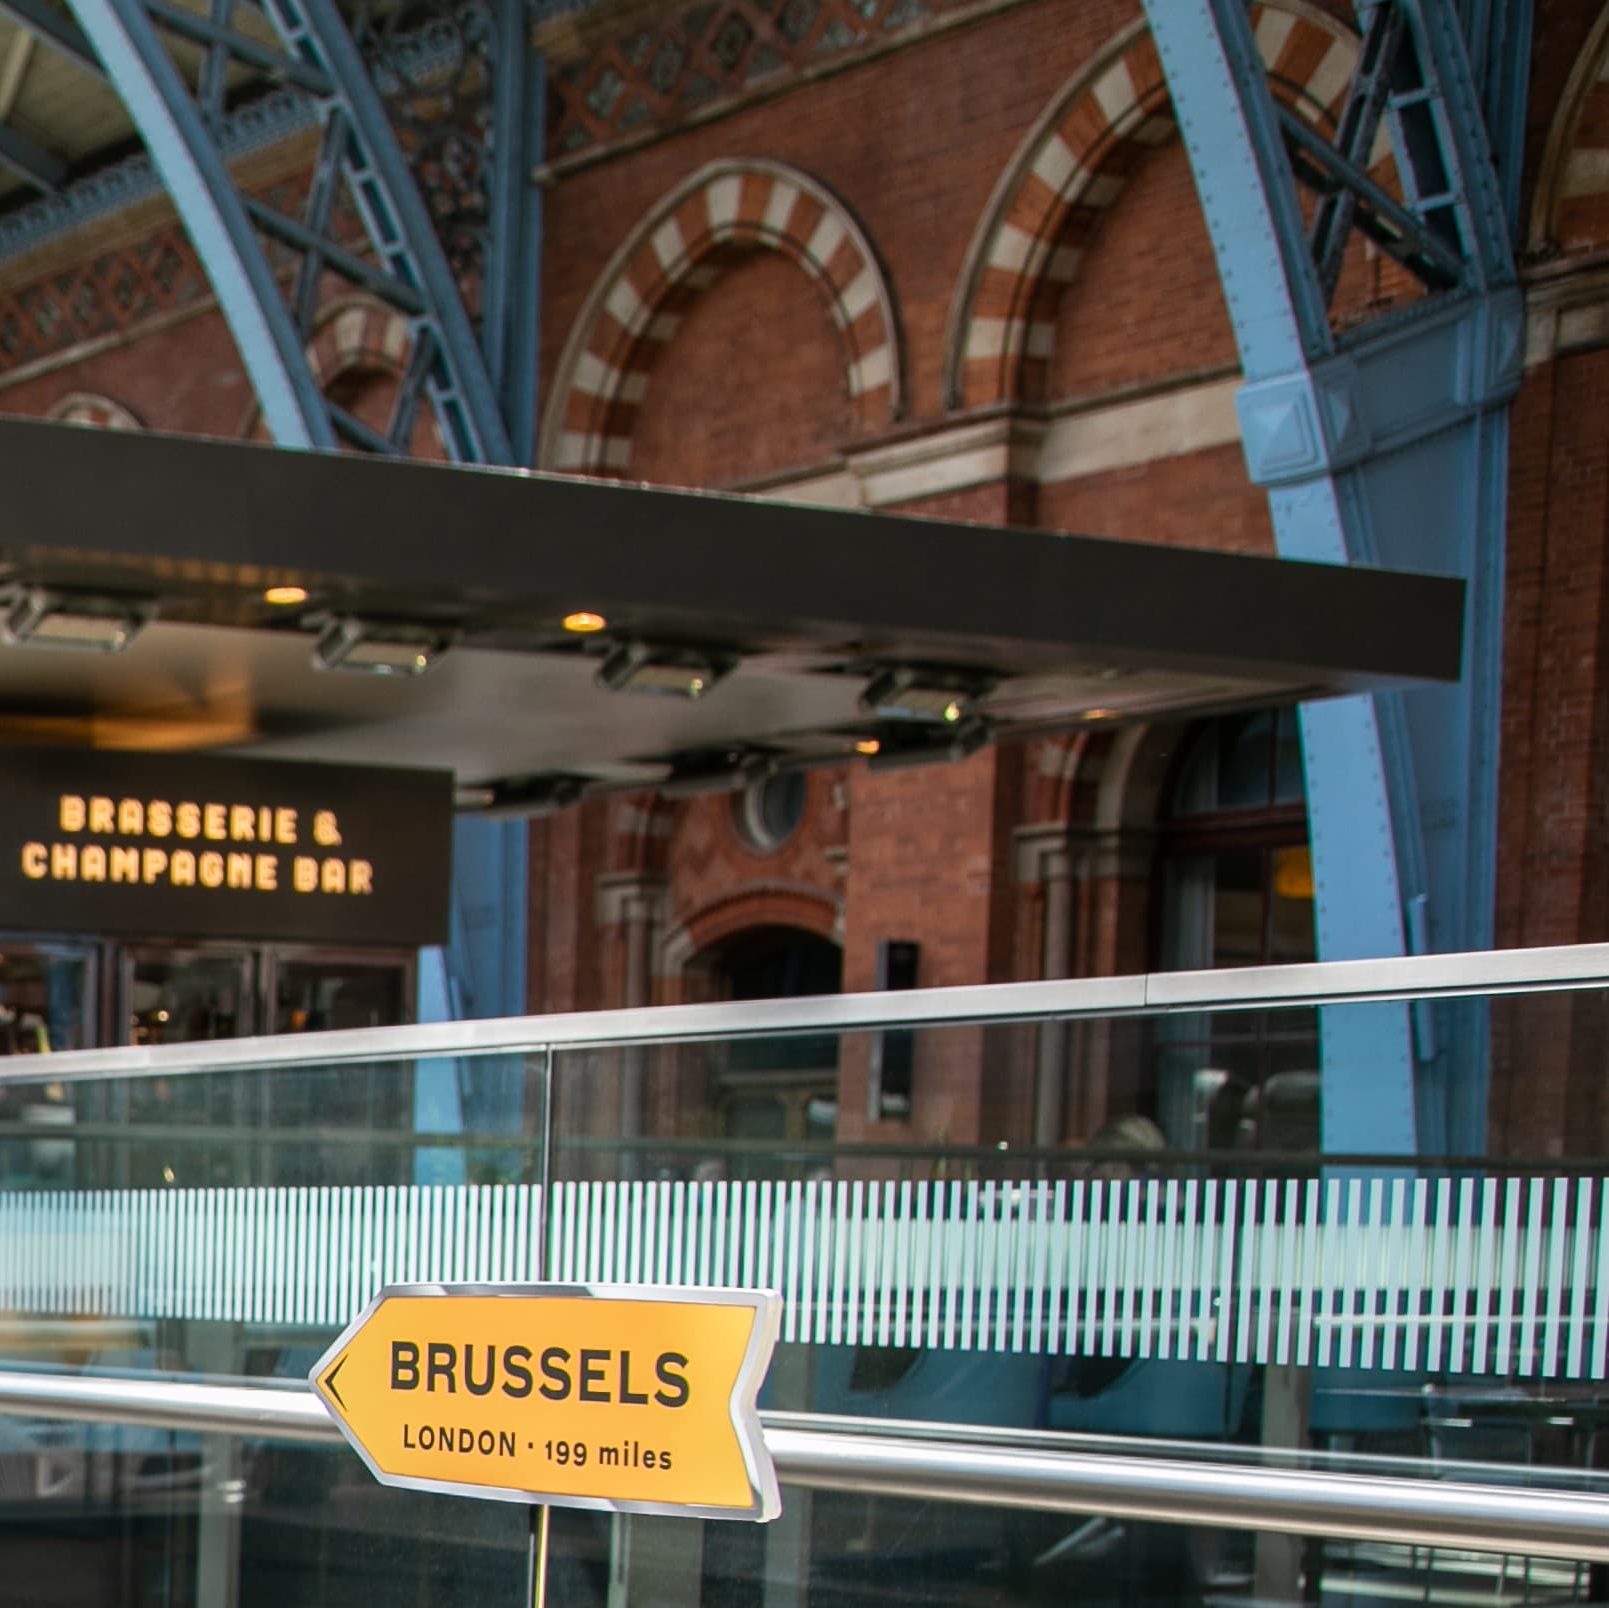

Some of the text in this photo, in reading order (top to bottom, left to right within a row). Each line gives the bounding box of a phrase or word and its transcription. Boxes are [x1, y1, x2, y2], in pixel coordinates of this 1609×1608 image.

[59, 793, 343, 847] BRASSERIE &
[21, 841, 374, 895] CHAMPAGNE BAR
[390, 1340, 690, 1408] BRUSSELS
[403, 1423, 516, 1457] LONDON
[544, 1440, 587, 1467] 199
[599, 1440, 672, 1470] miles
